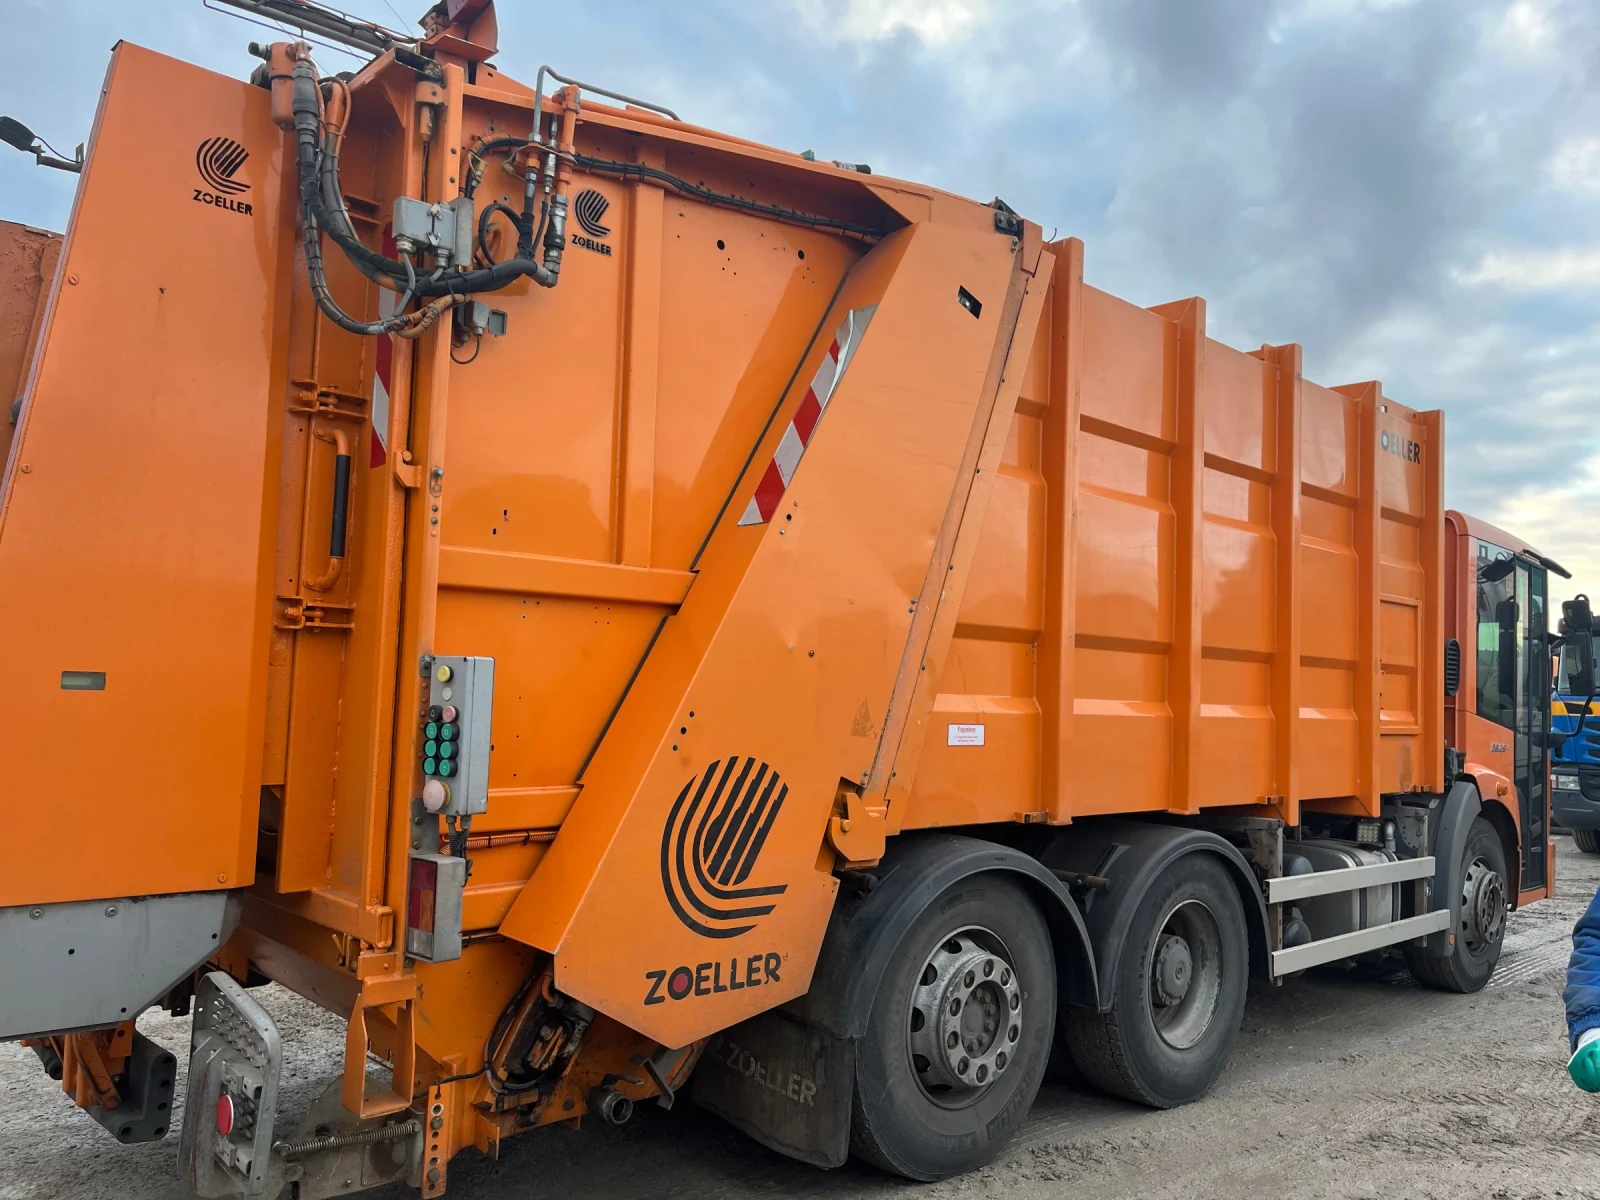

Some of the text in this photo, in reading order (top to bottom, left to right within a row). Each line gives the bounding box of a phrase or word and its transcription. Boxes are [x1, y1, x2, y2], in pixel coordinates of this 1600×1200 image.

[193, 189, 253, 217] ZOELLER
[571, 233, 612, 256] ZOELLER
[1381, 429, 1421, 465] OELLER
[643, 952, 782, 1006] ZOELLER
[727, 1043, 817, 1107] ZOELLER
